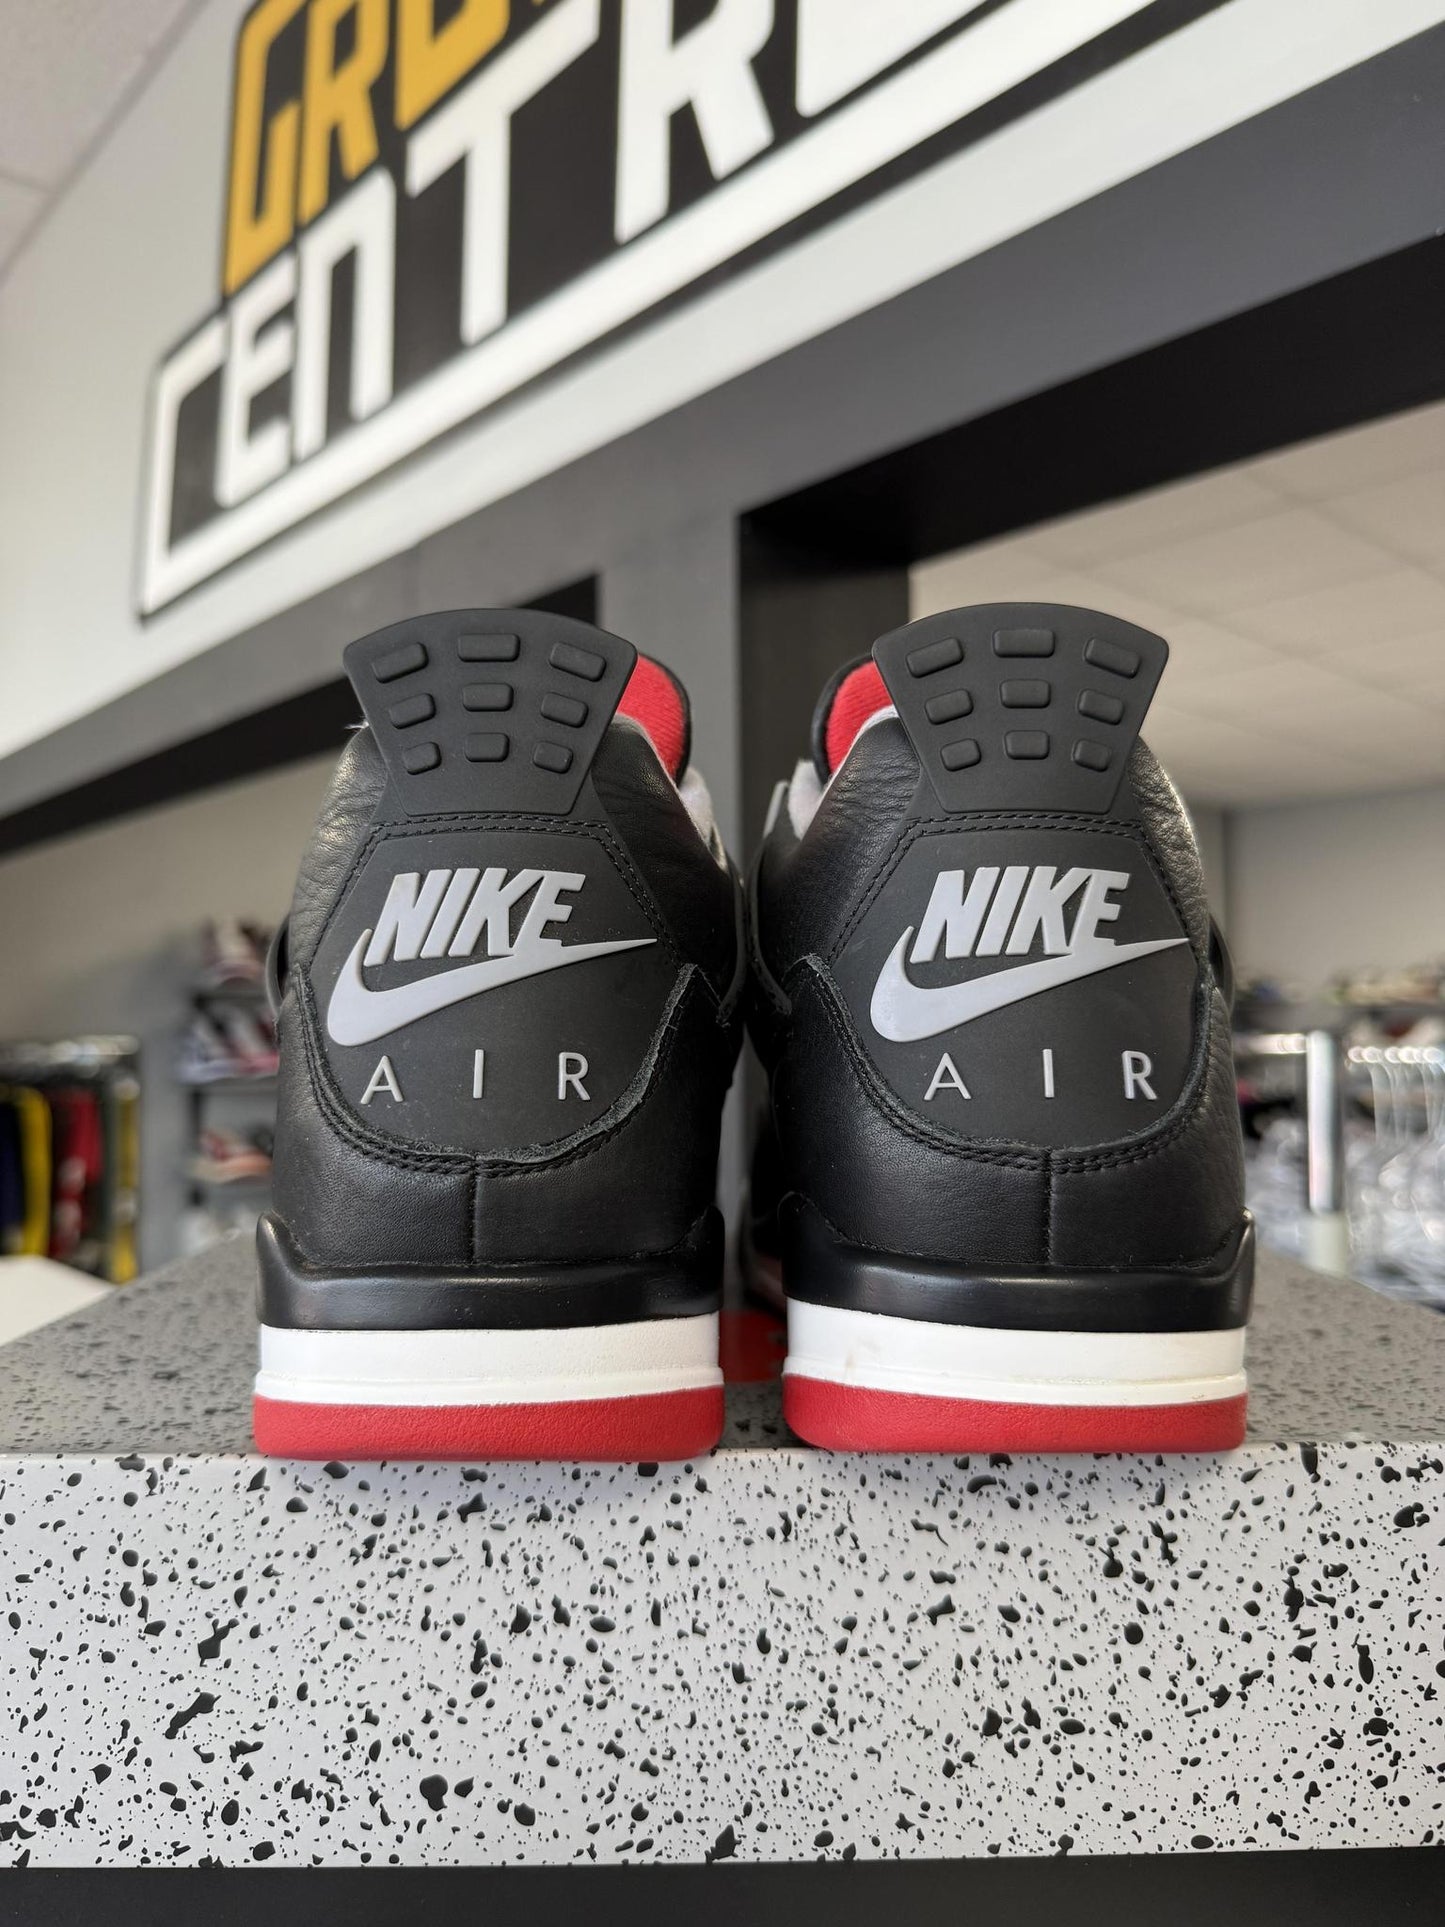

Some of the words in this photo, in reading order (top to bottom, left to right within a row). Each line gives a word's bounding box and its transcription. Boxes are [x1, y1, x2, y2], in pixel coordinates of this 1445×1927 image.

[362, 866, 588, 968] NIKE
[908, 865, 1132, 965] NIKE
[359, 1047, 592, 1105] AIR
[922, 1047, 1159, 1102] AIR
